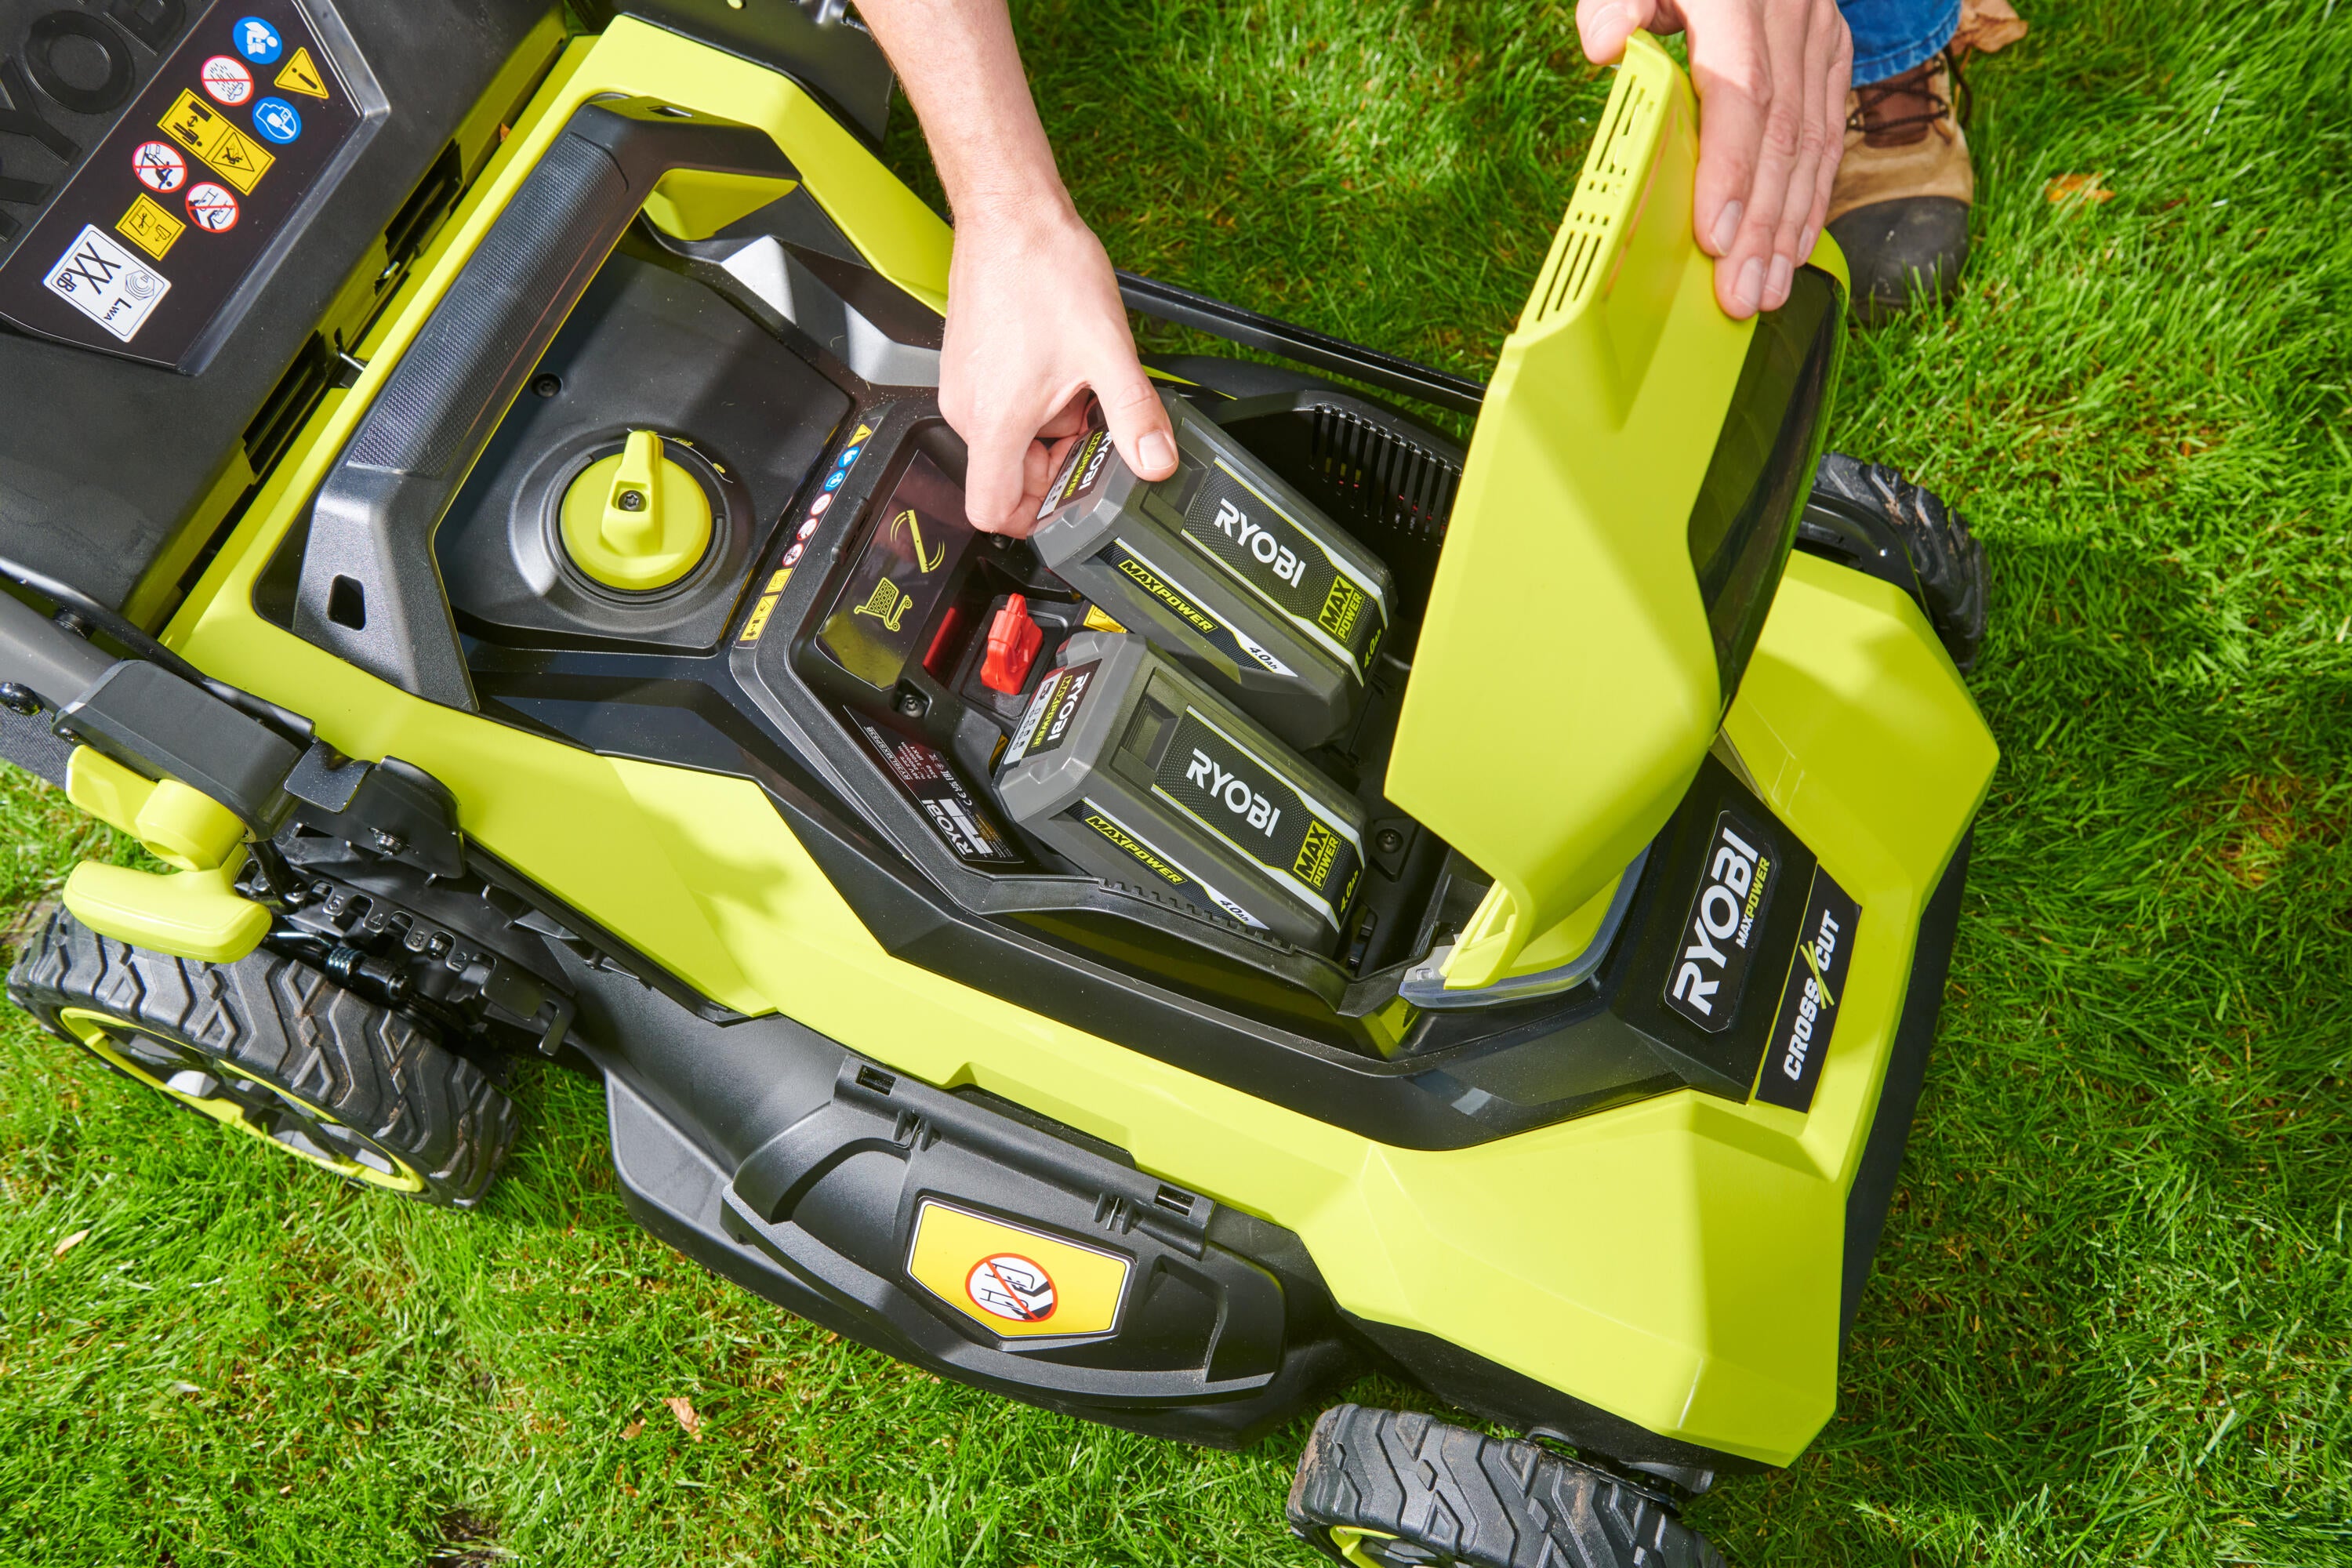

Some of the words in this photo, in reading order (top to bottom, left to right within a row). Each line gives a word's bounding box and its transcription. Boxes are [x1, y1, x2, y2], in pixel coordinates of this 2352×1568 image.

[56, 271, 77, 292] dB
[65, 240, 122, 295] XX
[1214, 498, 1306, 589] RYOBI
[1120, 561, 1214, 631] MAXPOWER
[1322, 580, 1352, 628] MAX
[1338, 593, 1363, 639] POWER
[1047, 672, 1091, 741] RYOBI
[1185, 747, 1281, 838] RYOBI
[921, 799, 974, 855] RYOBI
[1087, 817, 1185, 883] MAXPOWER
[1295, 825, 1328, 880] MAX
[1312, 836, 1340, 887] POWER
[328, 894, 345, 911] 5
[369, 913, 383, 926] 4
[1672, 827, 1759, 1016] RYOBI
[1735, 856, 1770, 949] MAXPOWER
[409, 930, 426, 948] 3
[1783, 977, 1820, 1082] CROSS
[1815, 909, 1839, 972] CUT
